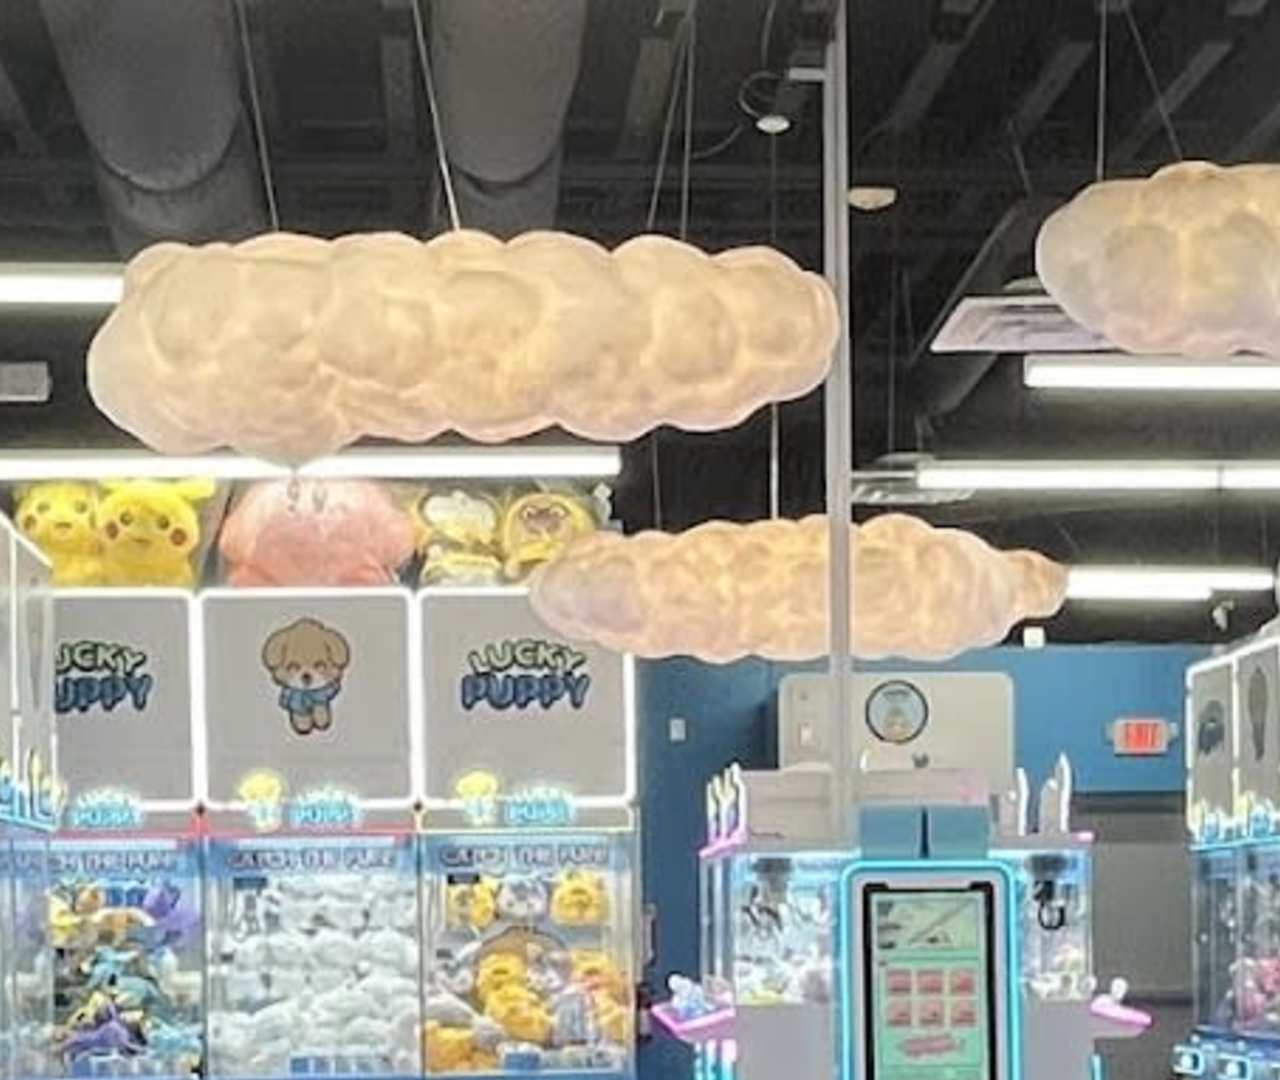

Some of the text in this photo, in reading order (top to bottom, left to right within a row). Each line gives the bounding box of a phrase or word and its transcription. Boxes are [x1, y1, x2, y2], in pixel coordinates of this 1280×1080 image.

[54, 640, 147, 677] UCKY
[467, 639, 586, 676] LUCKY
[54, 674, 153, 714] UPPY
[461, 670, 591, 711] PUPPY
